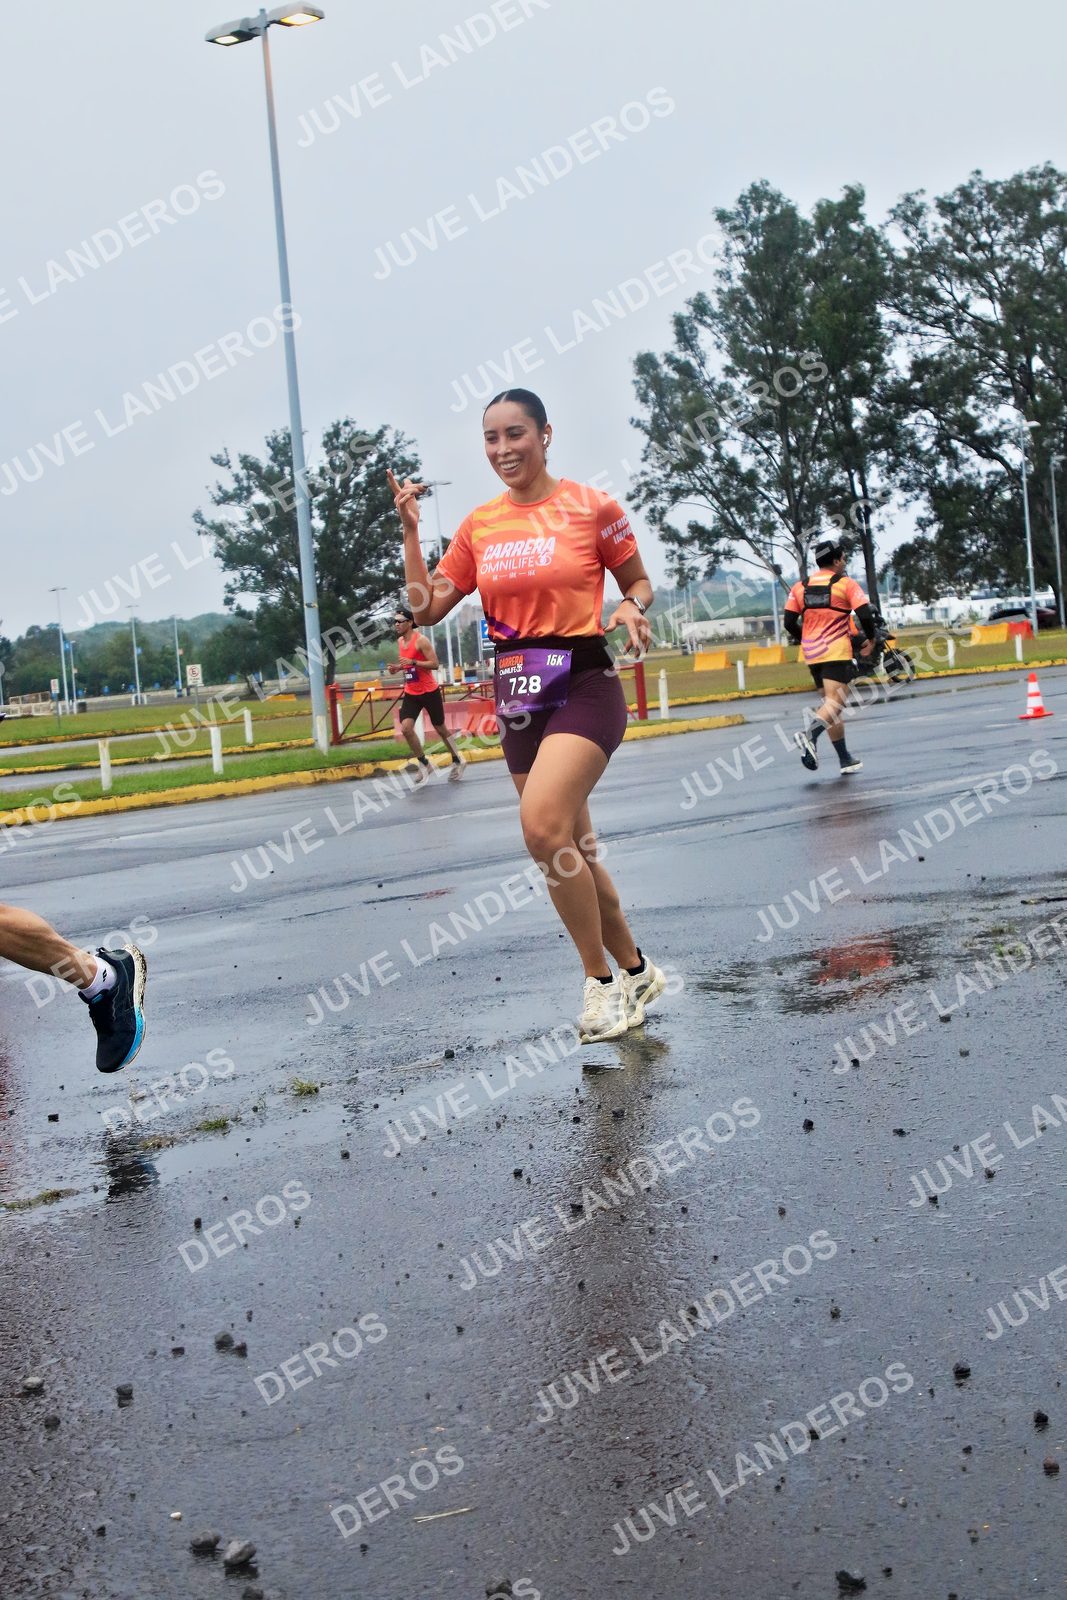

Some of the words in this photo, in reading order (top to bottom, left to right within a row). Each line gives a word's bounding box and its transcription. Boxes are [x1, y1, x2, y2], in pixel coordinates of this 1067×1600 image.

[482, 537, 556, 562] CARRERA
[480, 556, 535, 575] OMNILIFE
[499, 655, 524, 669] CARRERA
[546, 654, 564, 666] 16K
[509, 675, 542, 696] 728
